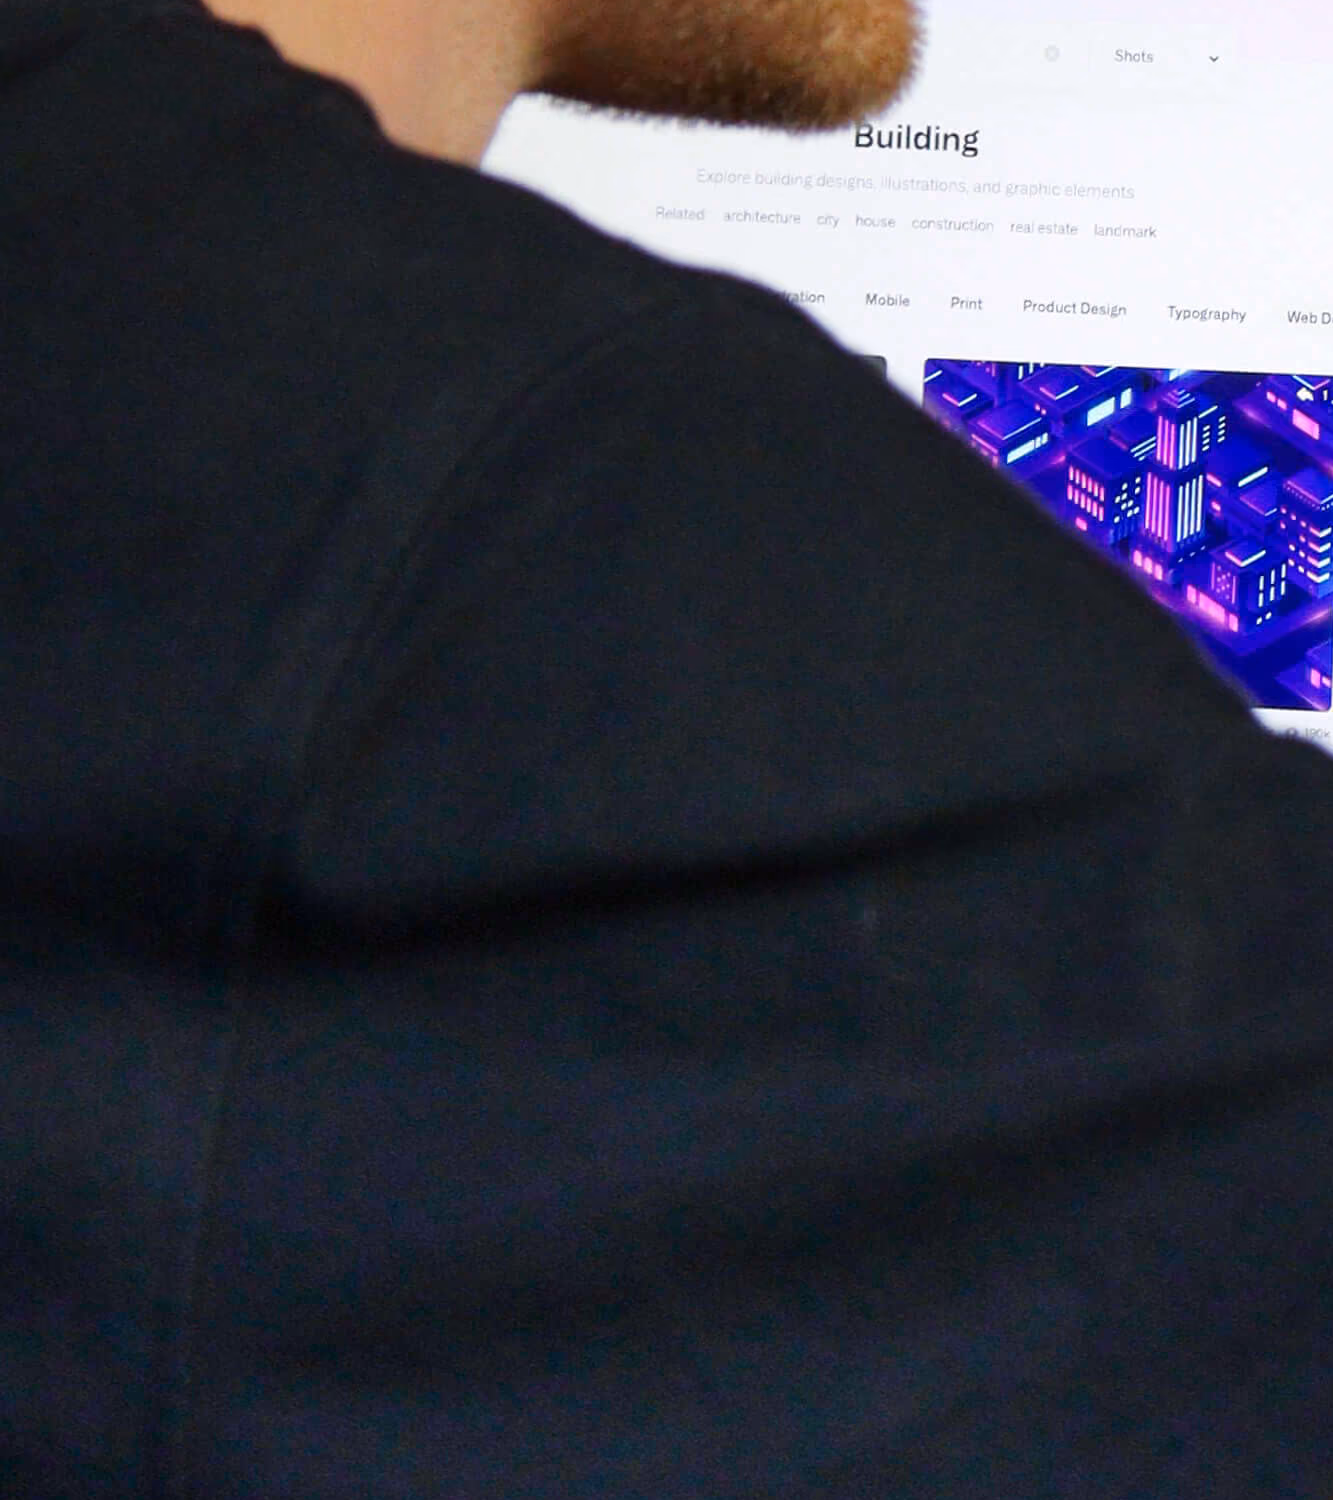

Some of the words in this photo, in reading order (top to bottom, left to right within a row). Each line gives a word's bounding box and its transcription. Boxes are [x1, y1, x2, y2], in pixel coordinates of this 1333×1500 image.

[1114, 49, 1154, 64] Shots
[855, 123, 980, 158] Building
[697, 168, 751, 186] Explore
[755, 171, 813, 189] building
[973, 180, 1001, 194] and
[1006, 181, 1061, 199] graphic
[1064, 184, 1136, 200] elements
[656, 205, 705, 221] Related
[723, 209, 801, 225] architecture
[817, 213, 840, 229] city
[855, 214, 896, 228] house
[911, 217, 995, 233] construction
[1010, 220, 1034, 234] real
[1037, 222, 1079, 236] estate
[1094, 223, 1158, 239] landmark
[865, 293, 911, 307] Mobile
[951, 296, 983, 311] Print
[1023, 299, 1077, 315] Product
[1081, 301, 1127, 318] Design
[1168, 305, 1247, 323] Typography
[1287, 310, 1317, 326] Web
